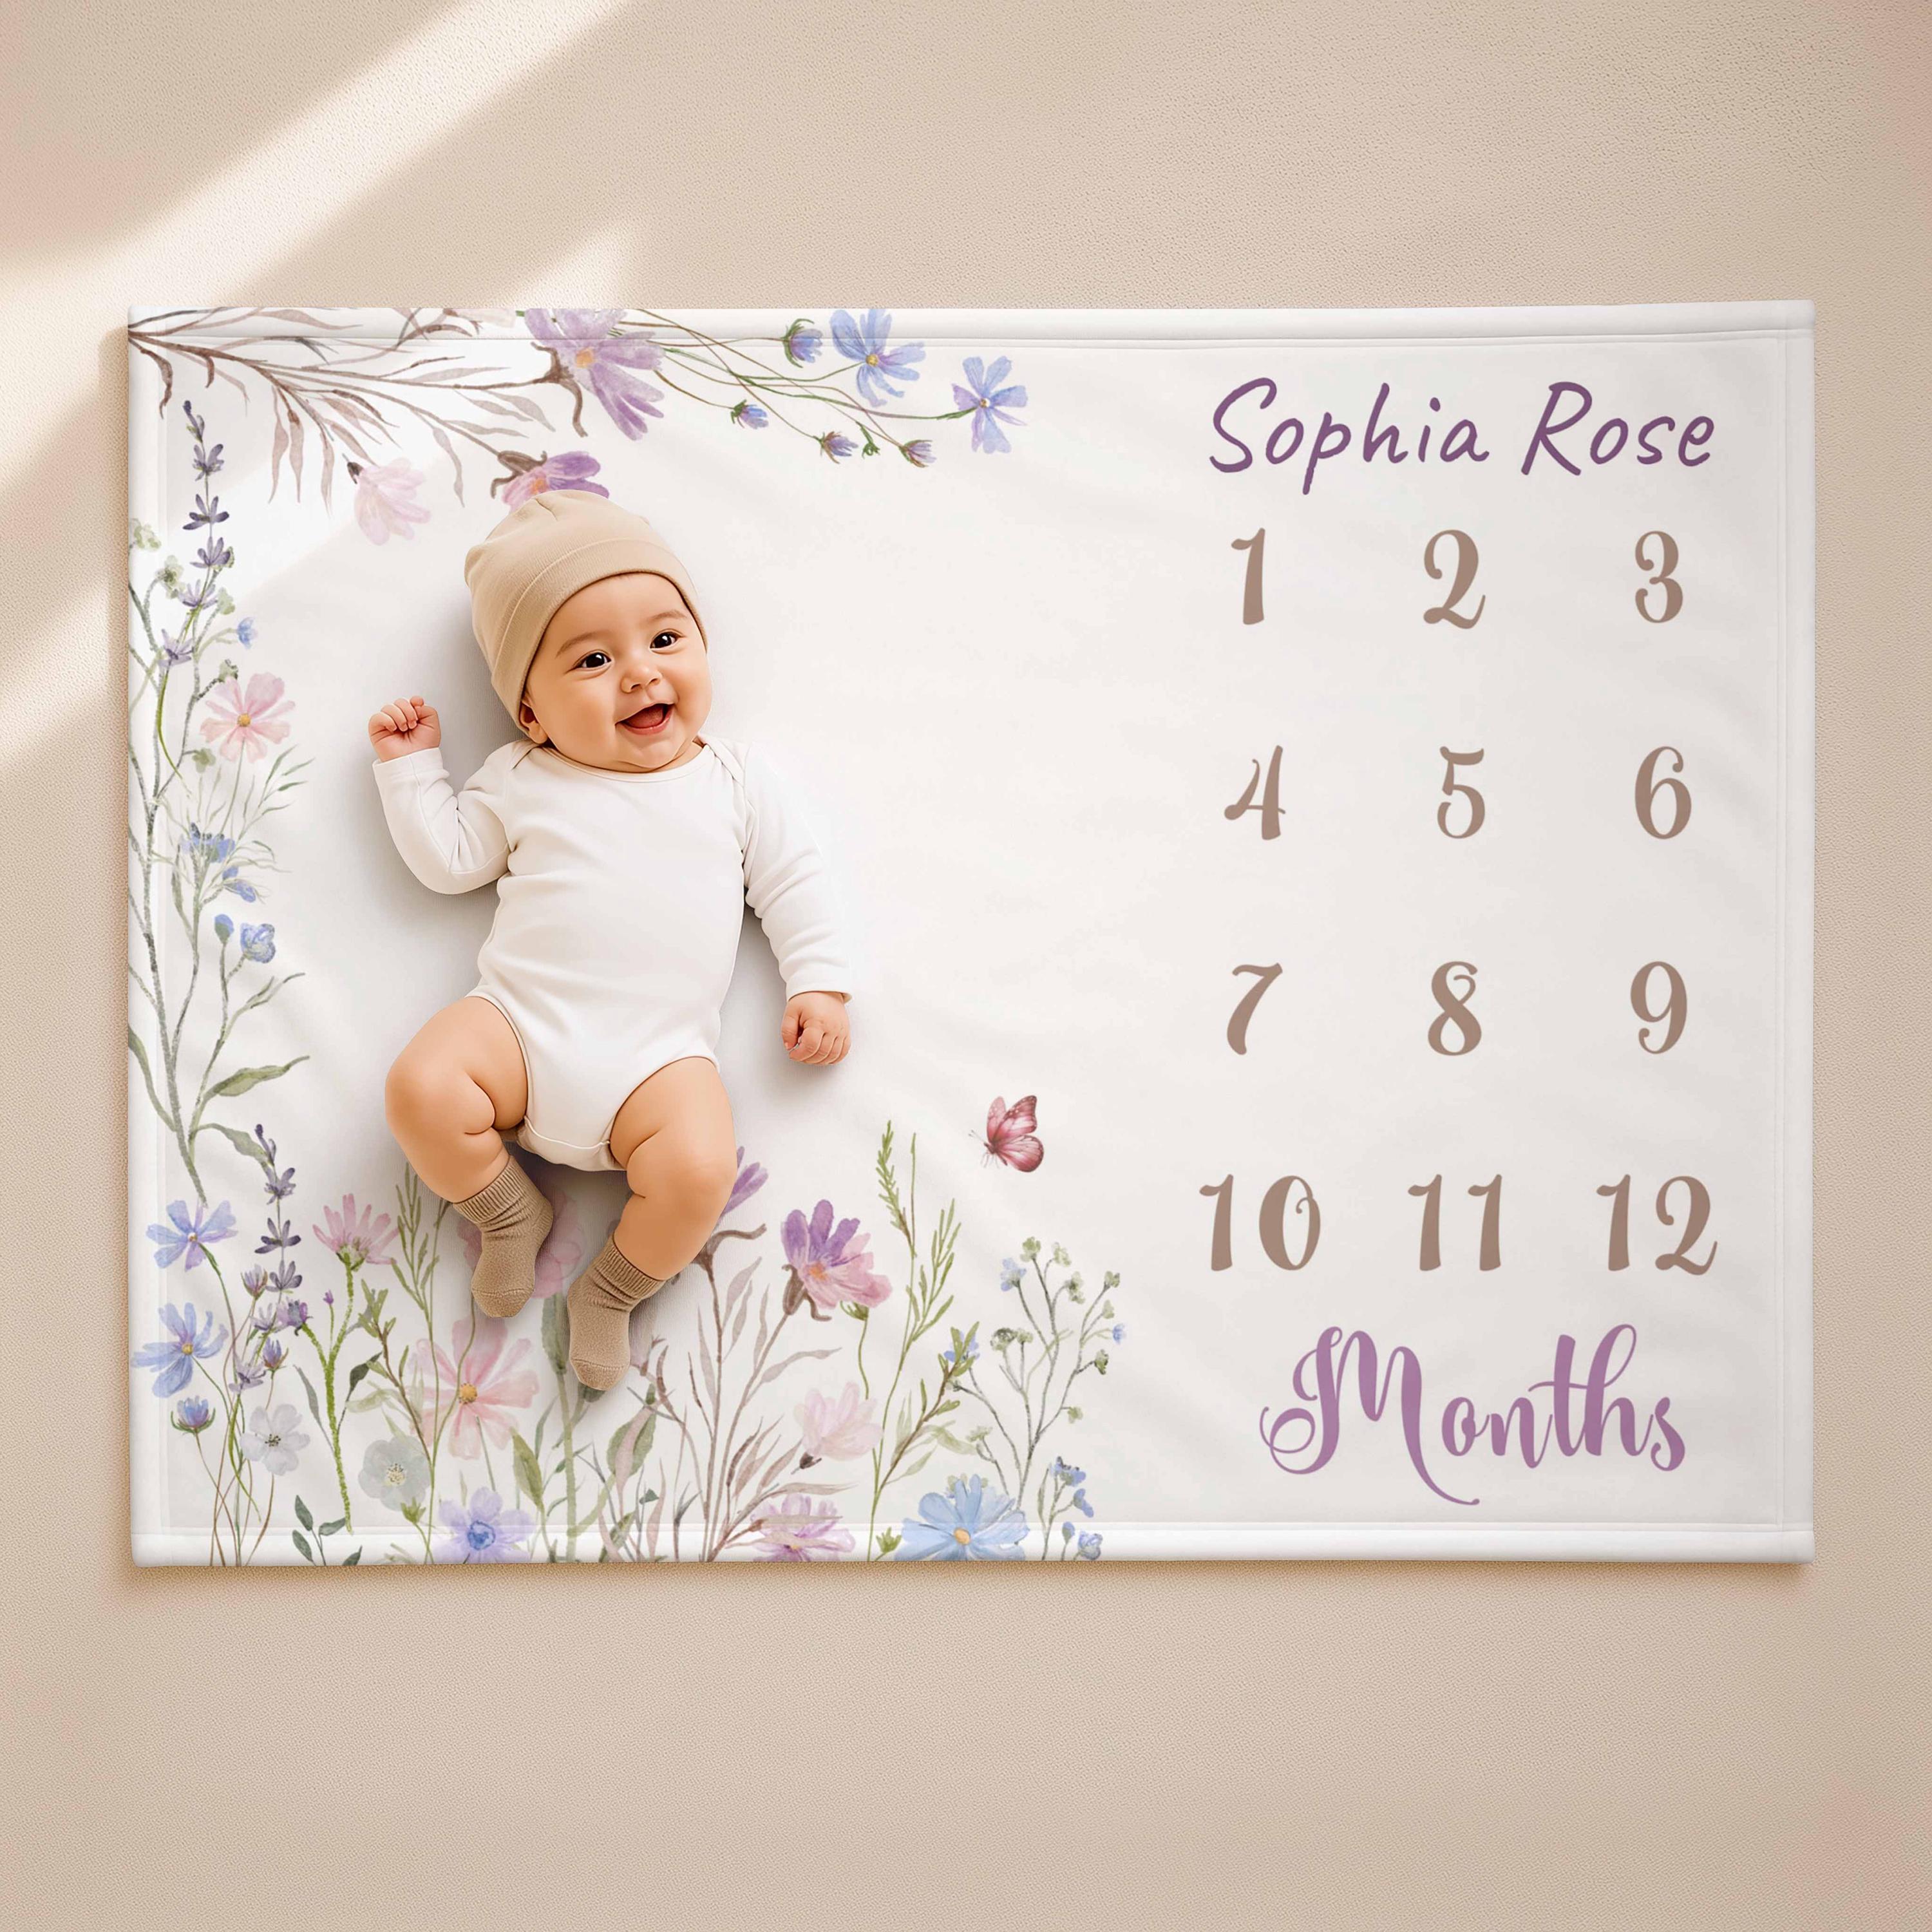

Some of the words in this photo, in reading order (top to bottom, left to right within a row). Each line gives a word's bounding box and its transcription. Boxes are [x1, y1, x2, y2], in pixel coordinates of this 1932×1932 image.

[1209, 377, 1490, 496] Sophia
[1520, 381, 1716, 477] Rose
[1231, 527, 1266, 625] 1
[1423, 529, 1486, 630] 2
[1634, 530, 1684, 624] 3
[1224, 744, 1286, 841] 4
[1437, 746, 1486, 839] 5
[1634, 746, 1692, 840] 6
[1226, 962, 1283, 1056] 7
[1427, 961, 1482, 1057] 8
[1630, 960, 1688, 1055] 9
[1198, 1173, 1321, 1272] 10
[1407, 1173, 1503, 1272] 11
[1595, 1173, 1718, 1276] 12
[1259, 1323, 1686, 1506] Months
